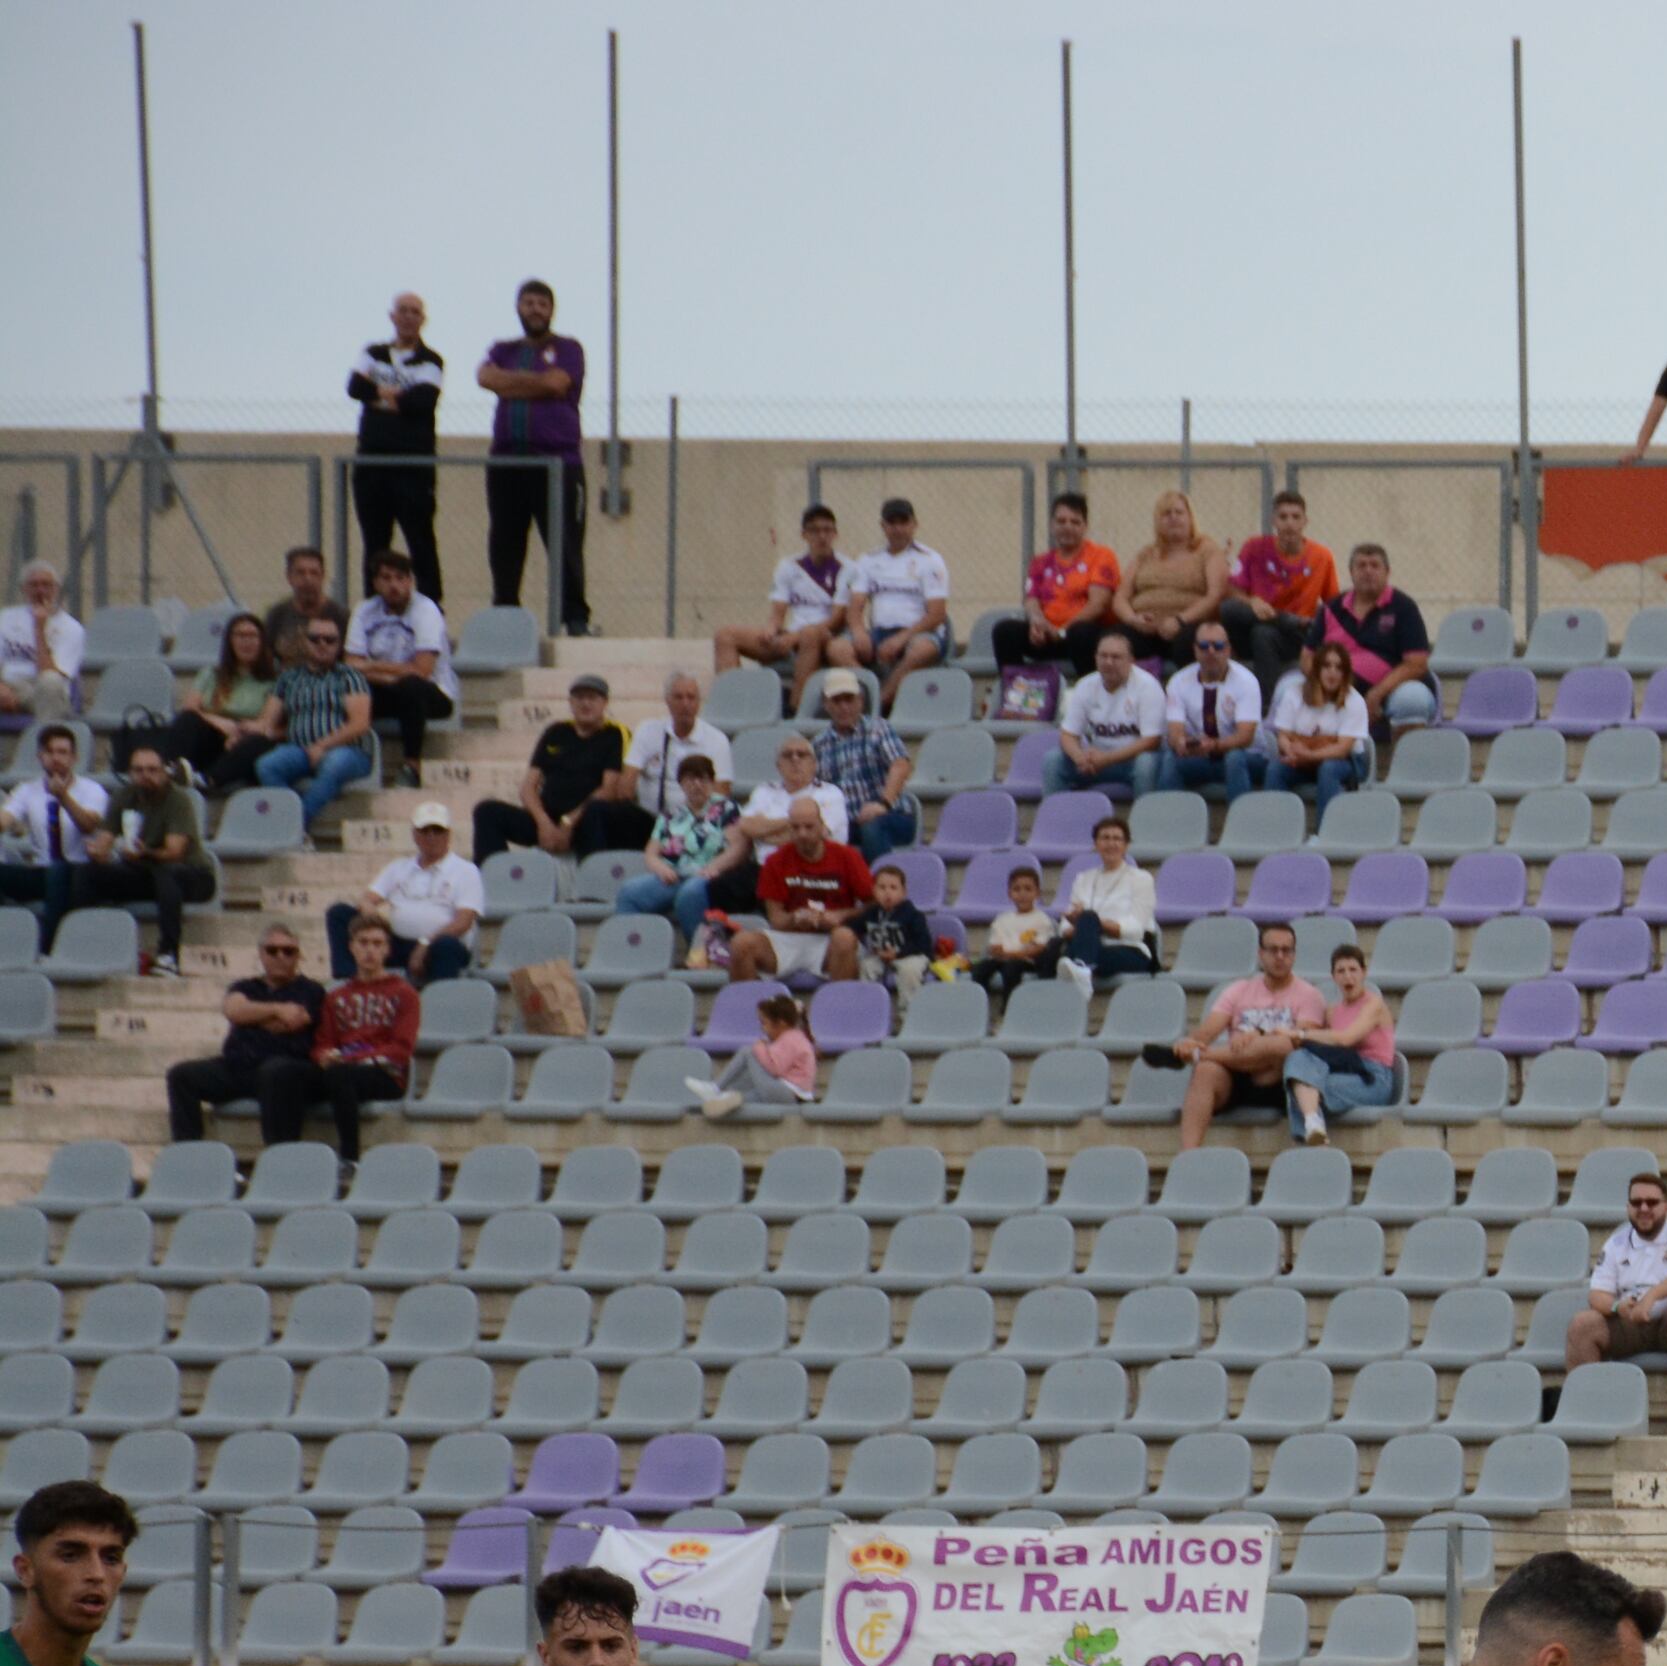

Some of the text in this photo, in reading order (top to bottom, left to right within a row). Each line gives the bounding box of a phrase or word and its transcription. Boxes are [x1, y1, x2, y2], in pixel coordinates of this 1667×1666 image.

[933, 1536, 1264, 1567] Peña AMIGOS
[933, 1582, 1005, 1612] DEL
